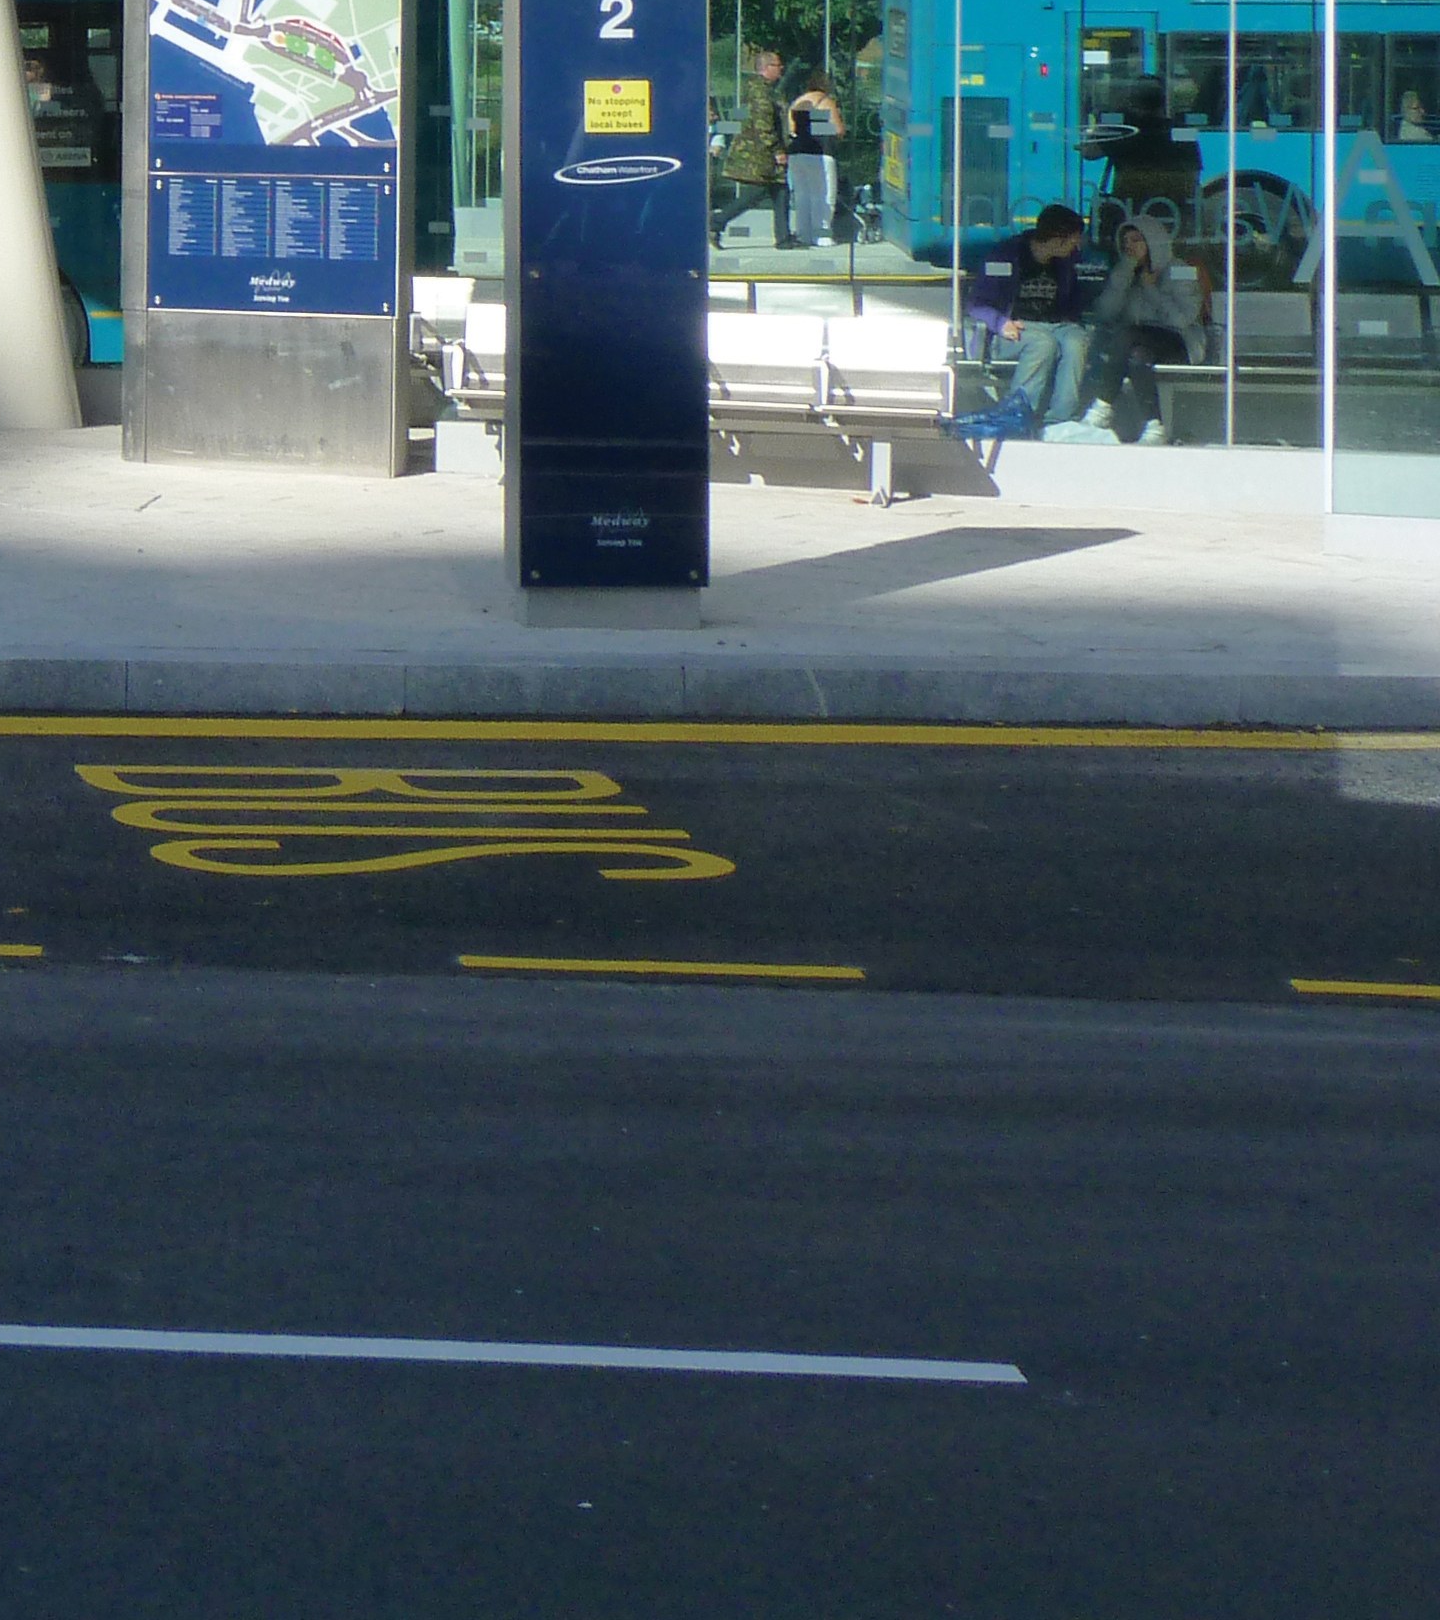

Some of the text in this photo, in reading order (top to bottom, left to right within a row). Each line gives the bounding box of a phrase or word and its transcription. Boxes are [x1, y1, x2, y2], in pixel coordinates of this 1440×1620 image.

[588, 97, 645, 107] No stopping
[601, 109, 633, 119] except
[590, 120, 643, 129] local buses
[576, 166, 617, 175] Chatham
[73, 763, 737, 881] BUS
